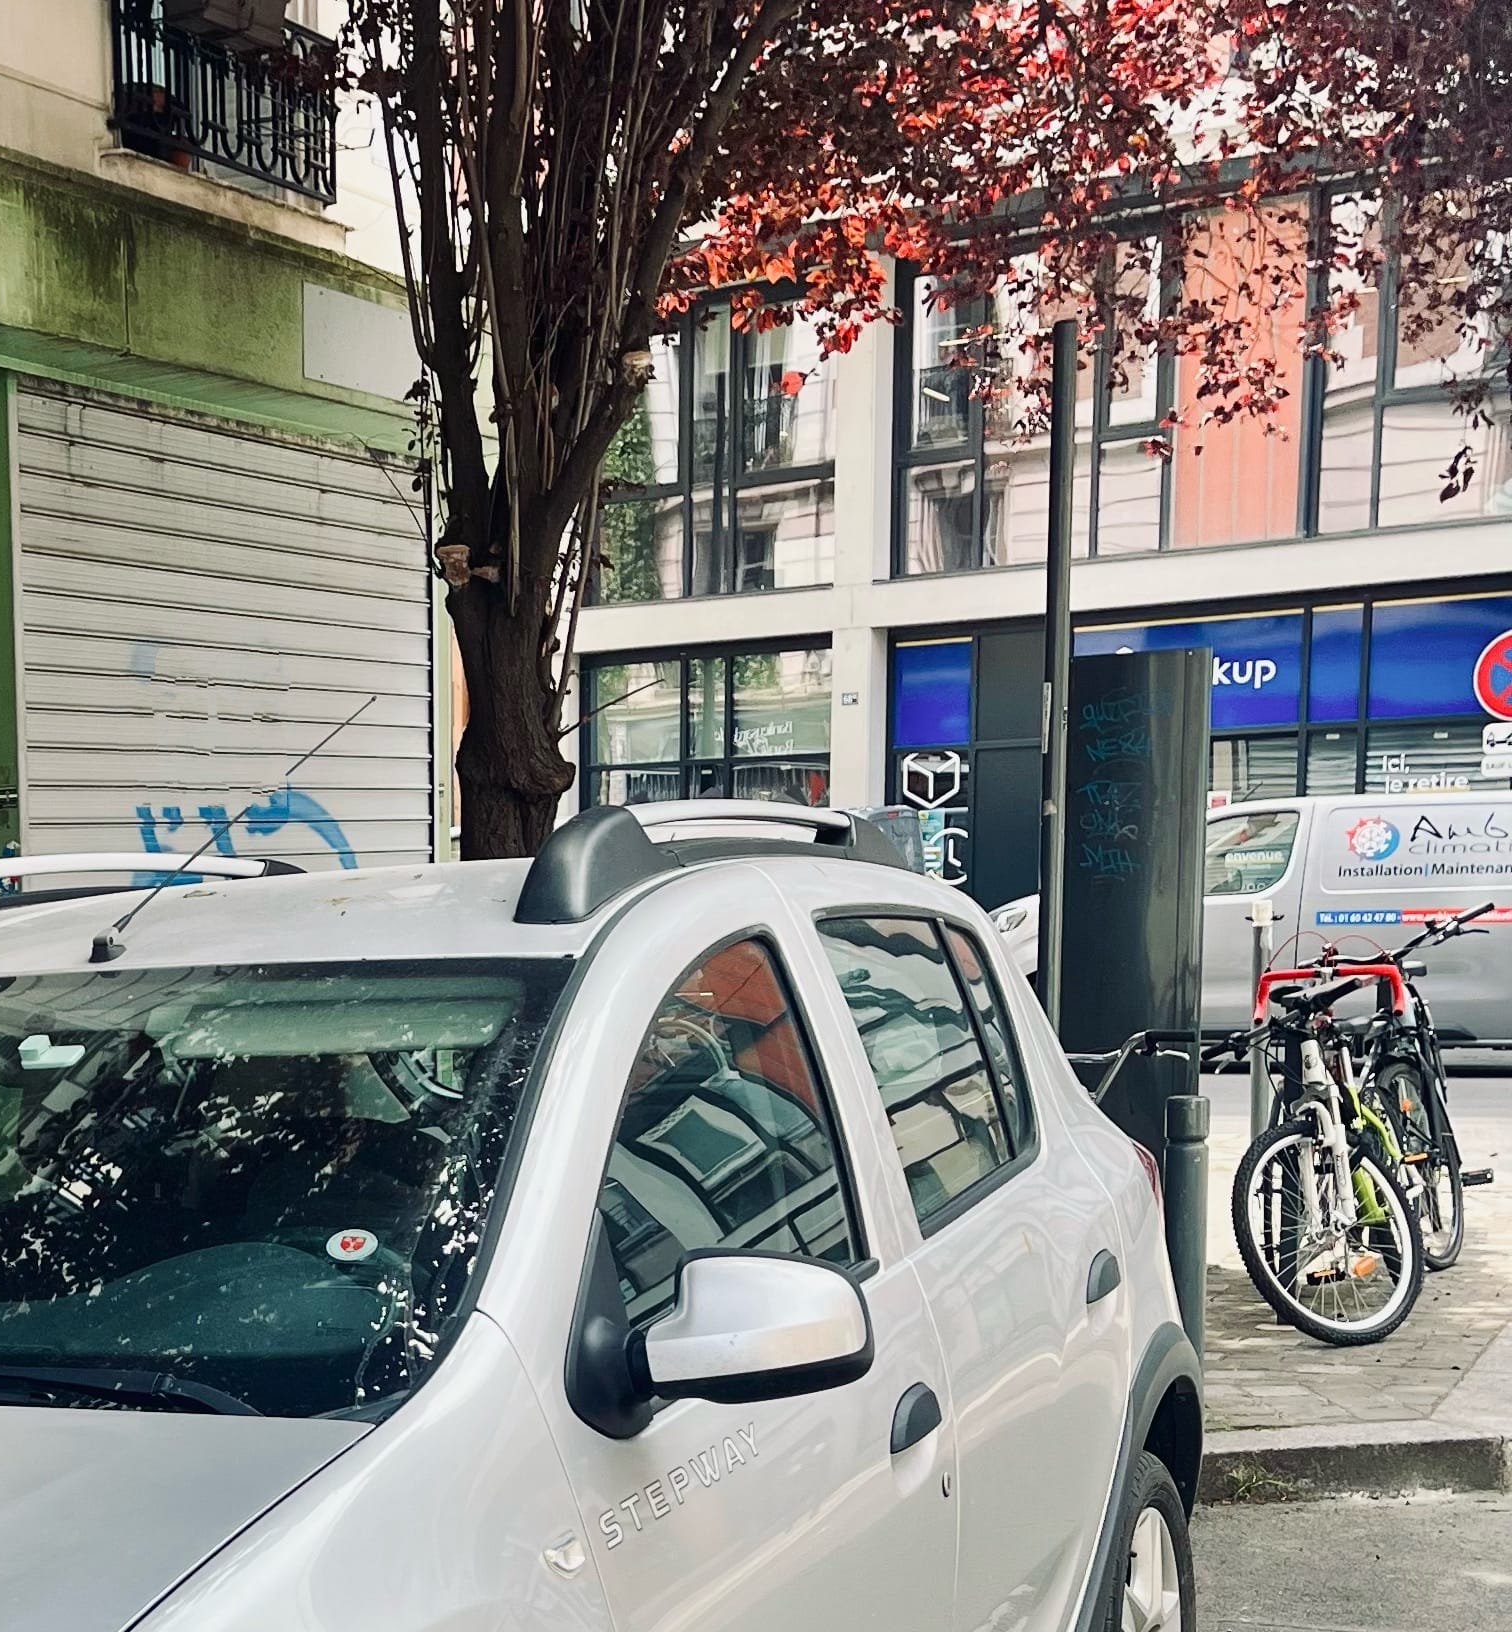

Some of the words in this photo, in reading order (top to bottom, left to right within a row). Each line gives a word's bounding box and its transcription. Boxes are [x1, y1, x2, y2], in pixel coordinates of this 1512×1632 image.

[1407, 771, 1469, 789] retire
[1338, 864, 1423, 878] Installation
[598, 1421, 761, 1550] STEPWAY
